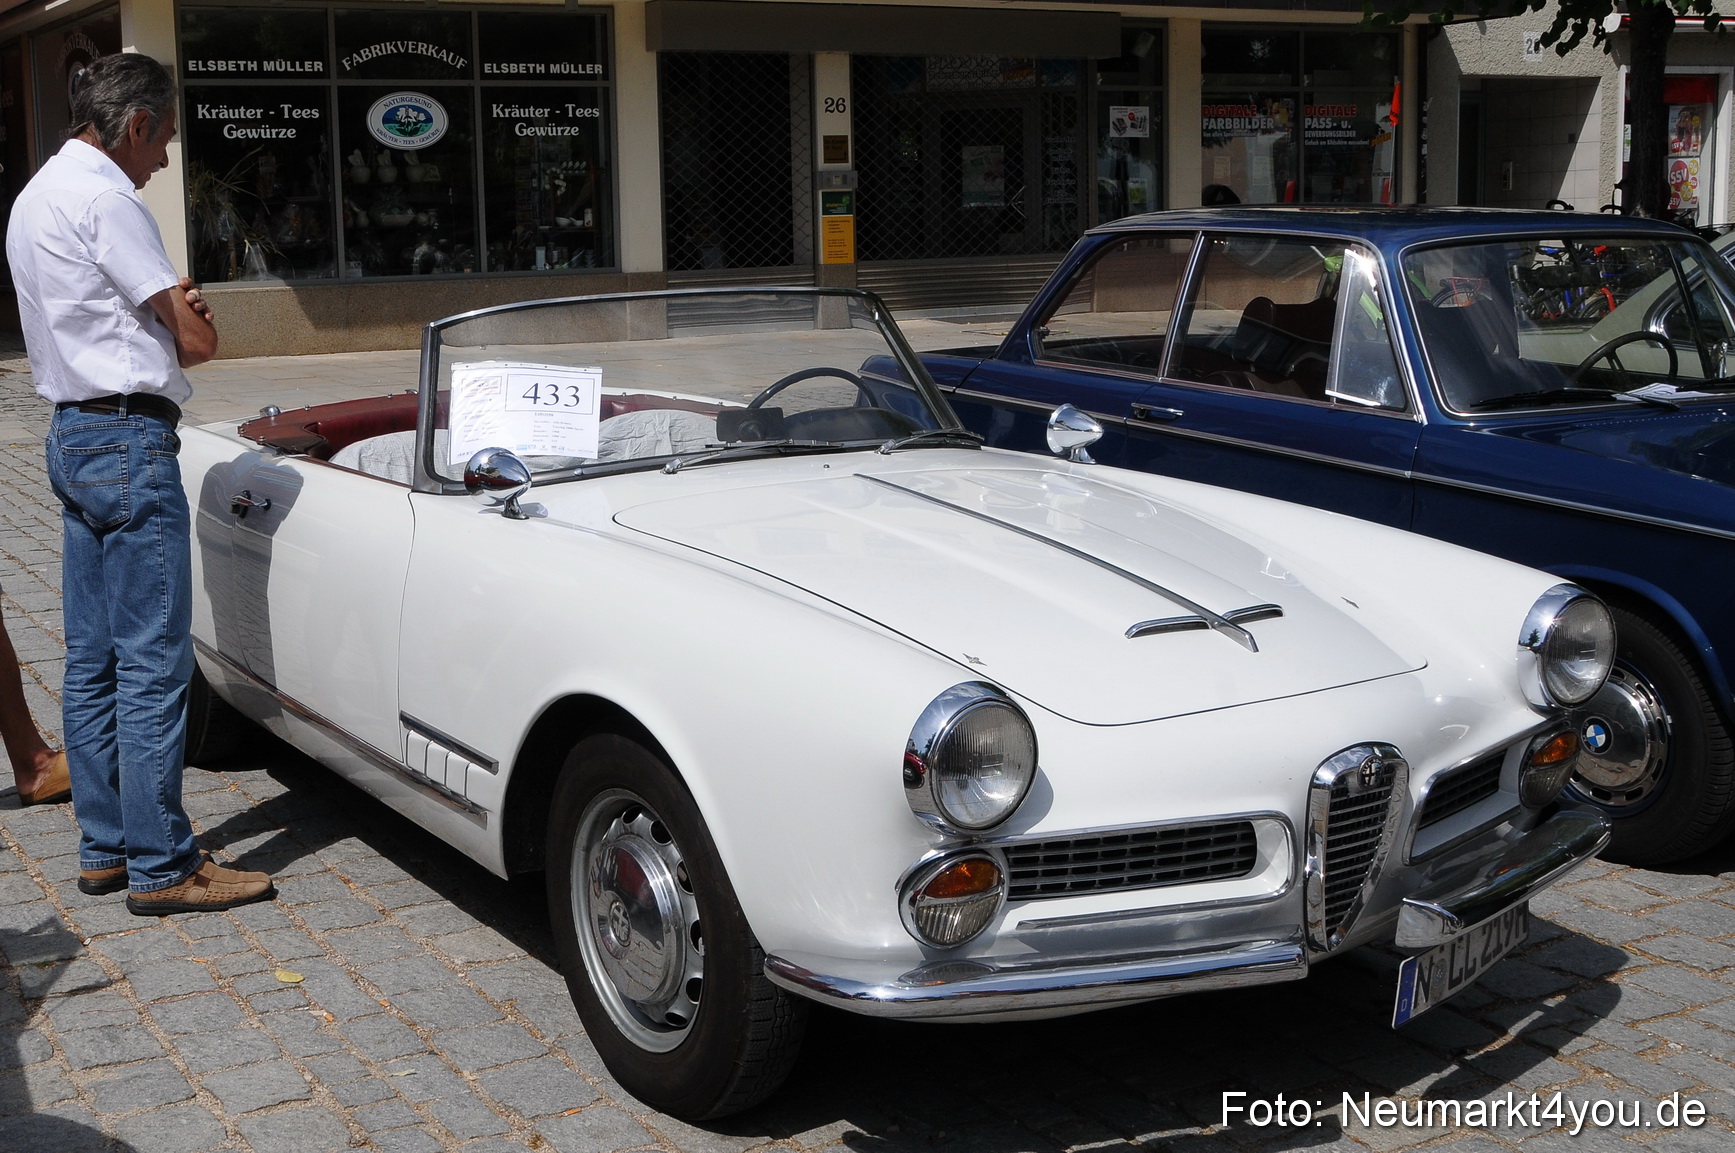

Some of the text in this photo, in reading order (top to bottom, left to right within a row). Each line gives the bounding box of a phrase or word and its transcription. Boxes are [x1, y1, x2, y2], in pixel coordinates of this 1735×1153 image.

[341, 40, 468, 71] FABRIKVERKAUF
[188, 59, 324, 72] ELSBETH MÜLLER
[484, 62, 603, 74] ELSBETH MÜLLER
[383, 96, 432, 109] NATURGESUND
[824, 97, 847, 114] 26
[196, 104, 264, 119] Kräuter
[280, 104, 320, 119] Tees
[492, 104, 551, 118] Kräuter
[565, 104, 600, 118] Tees
[1202, 105, 1257, 117] DIGITALE
[1304, 105, 1357, 117] DIGITALE
[514, 122, 580, 137] Gewürze
[1203, 118, 1274, 130] FARBBILDER
[1305, 118, 1338, 129] PASS-
[223, 124, 297, 139] Gewürze
[1305, 130, 1356, 138] BEWERBUNGSBILDER
[1671, 168, 1687, 184] SSV
[522, 382, 580, 407] 433
[1413, 956, 1434, 1010] N
[1401, 998, 1408, 1013] D
